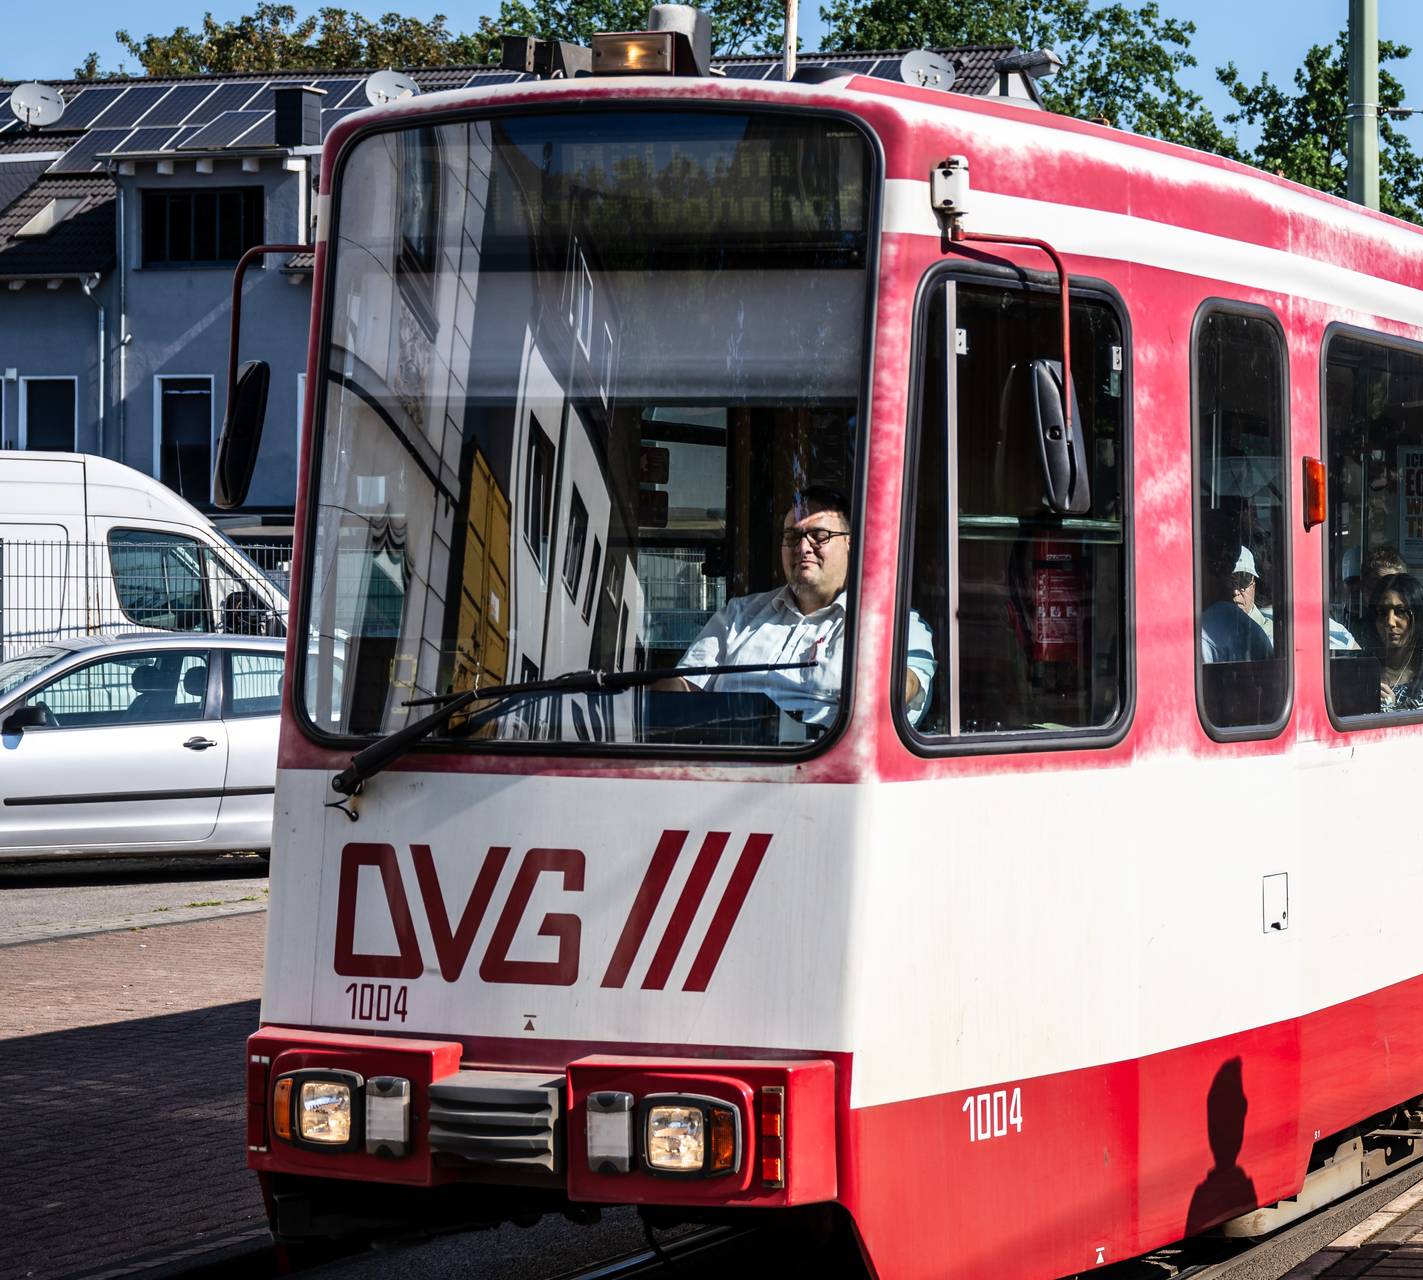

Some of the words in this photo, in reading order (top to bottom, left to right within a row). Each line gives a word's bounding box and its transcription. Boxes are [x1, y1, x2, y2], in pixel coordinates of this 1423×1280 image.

[334, 842, 586, 986] DVG
[345, 983, 408, 1023] 1004
[962, 1087, 1023, 1142] 1004
